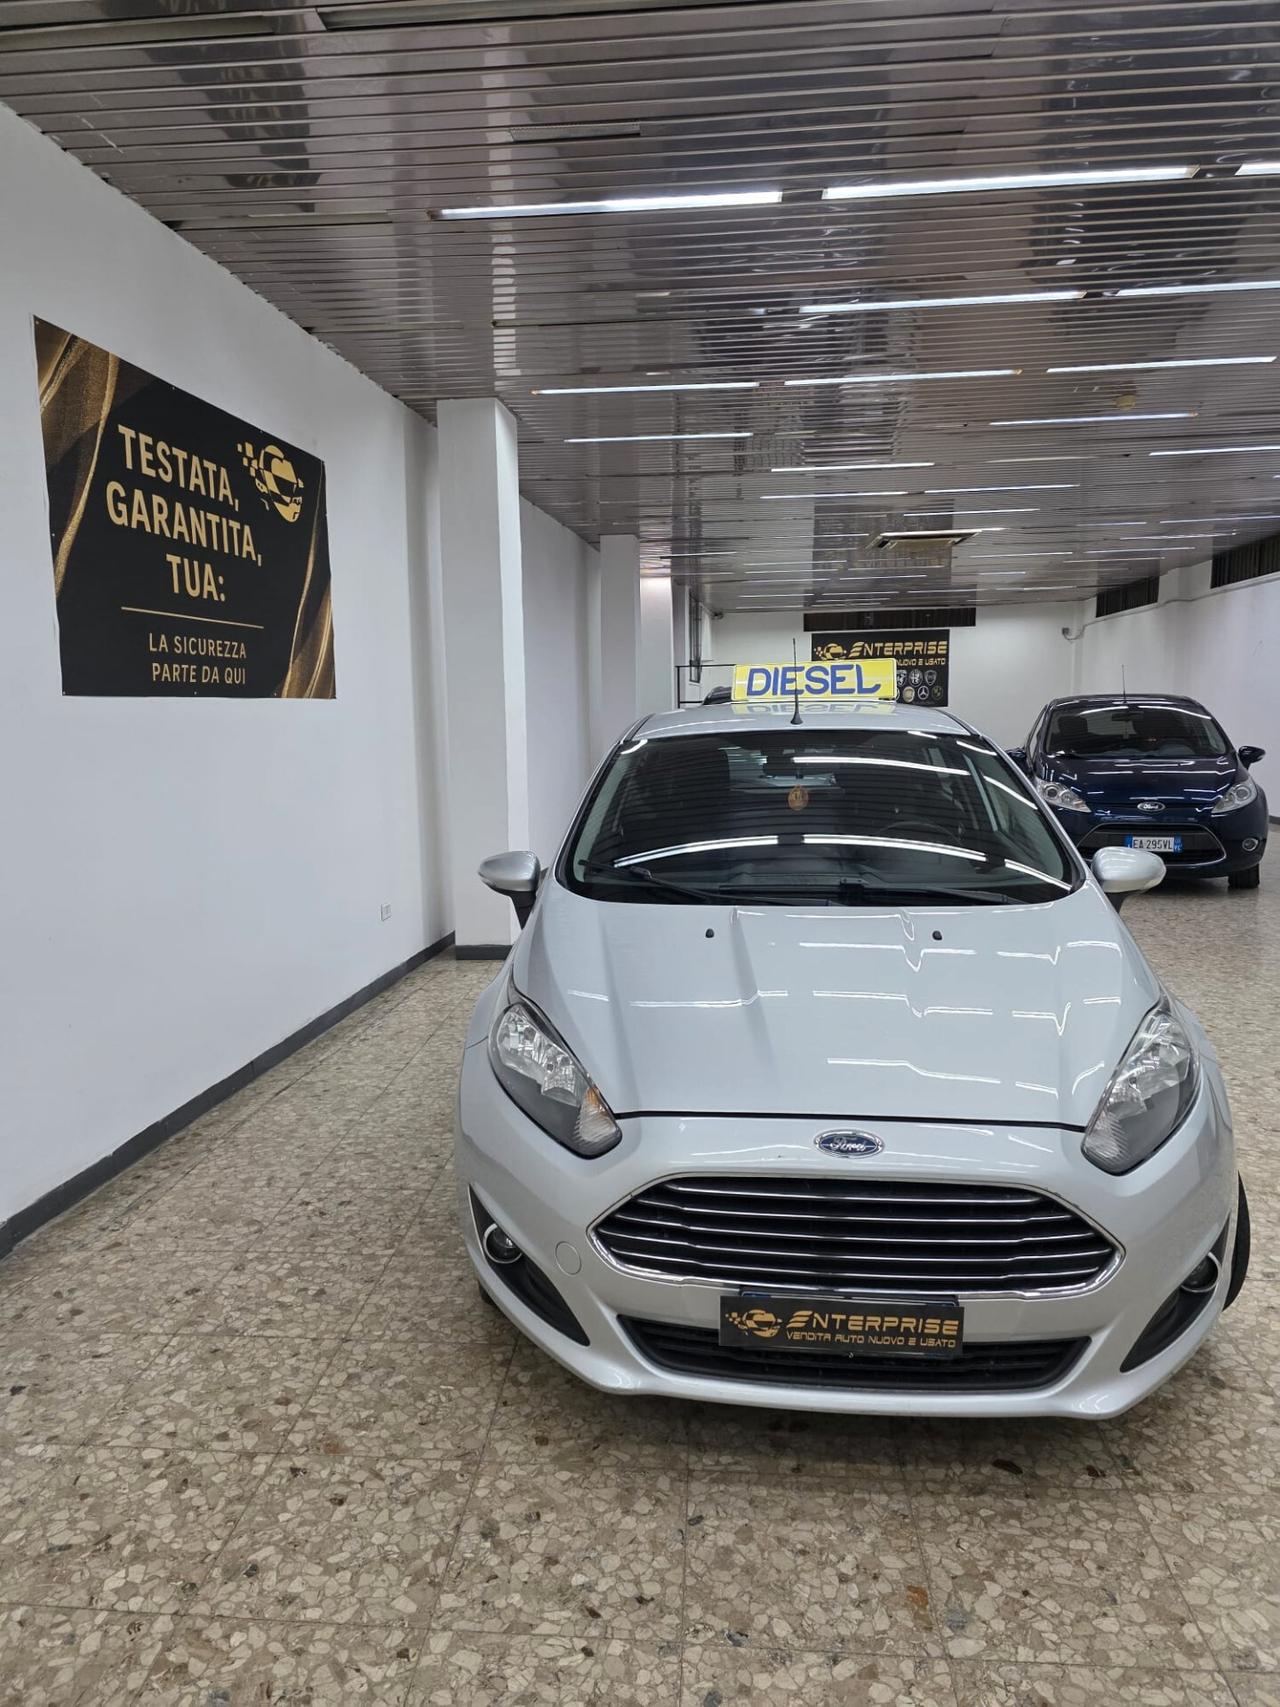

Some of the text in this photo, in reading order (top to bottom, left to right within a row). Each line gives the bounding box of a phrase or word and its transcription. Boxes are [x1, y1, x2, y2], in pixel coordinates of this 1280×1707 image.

[117, 425, 240, 512] TESTATA,
[106, 481, 262, 567] GARANTITA,
[165, 554, 226, 602] TUA:
[149, 633, 247, 659] LA SICUREZZA
[849, 640, 948, 657] ENTERPRISE
[152, 662, 246, 685] PARTE DA QUI
[746, 664, 882, 697] DIESEL
[786, 1310, 959, 1336] ENTERPRISE
[786, 1331, 957, 1349] VENDITA AUTO NUOVO E USATO
